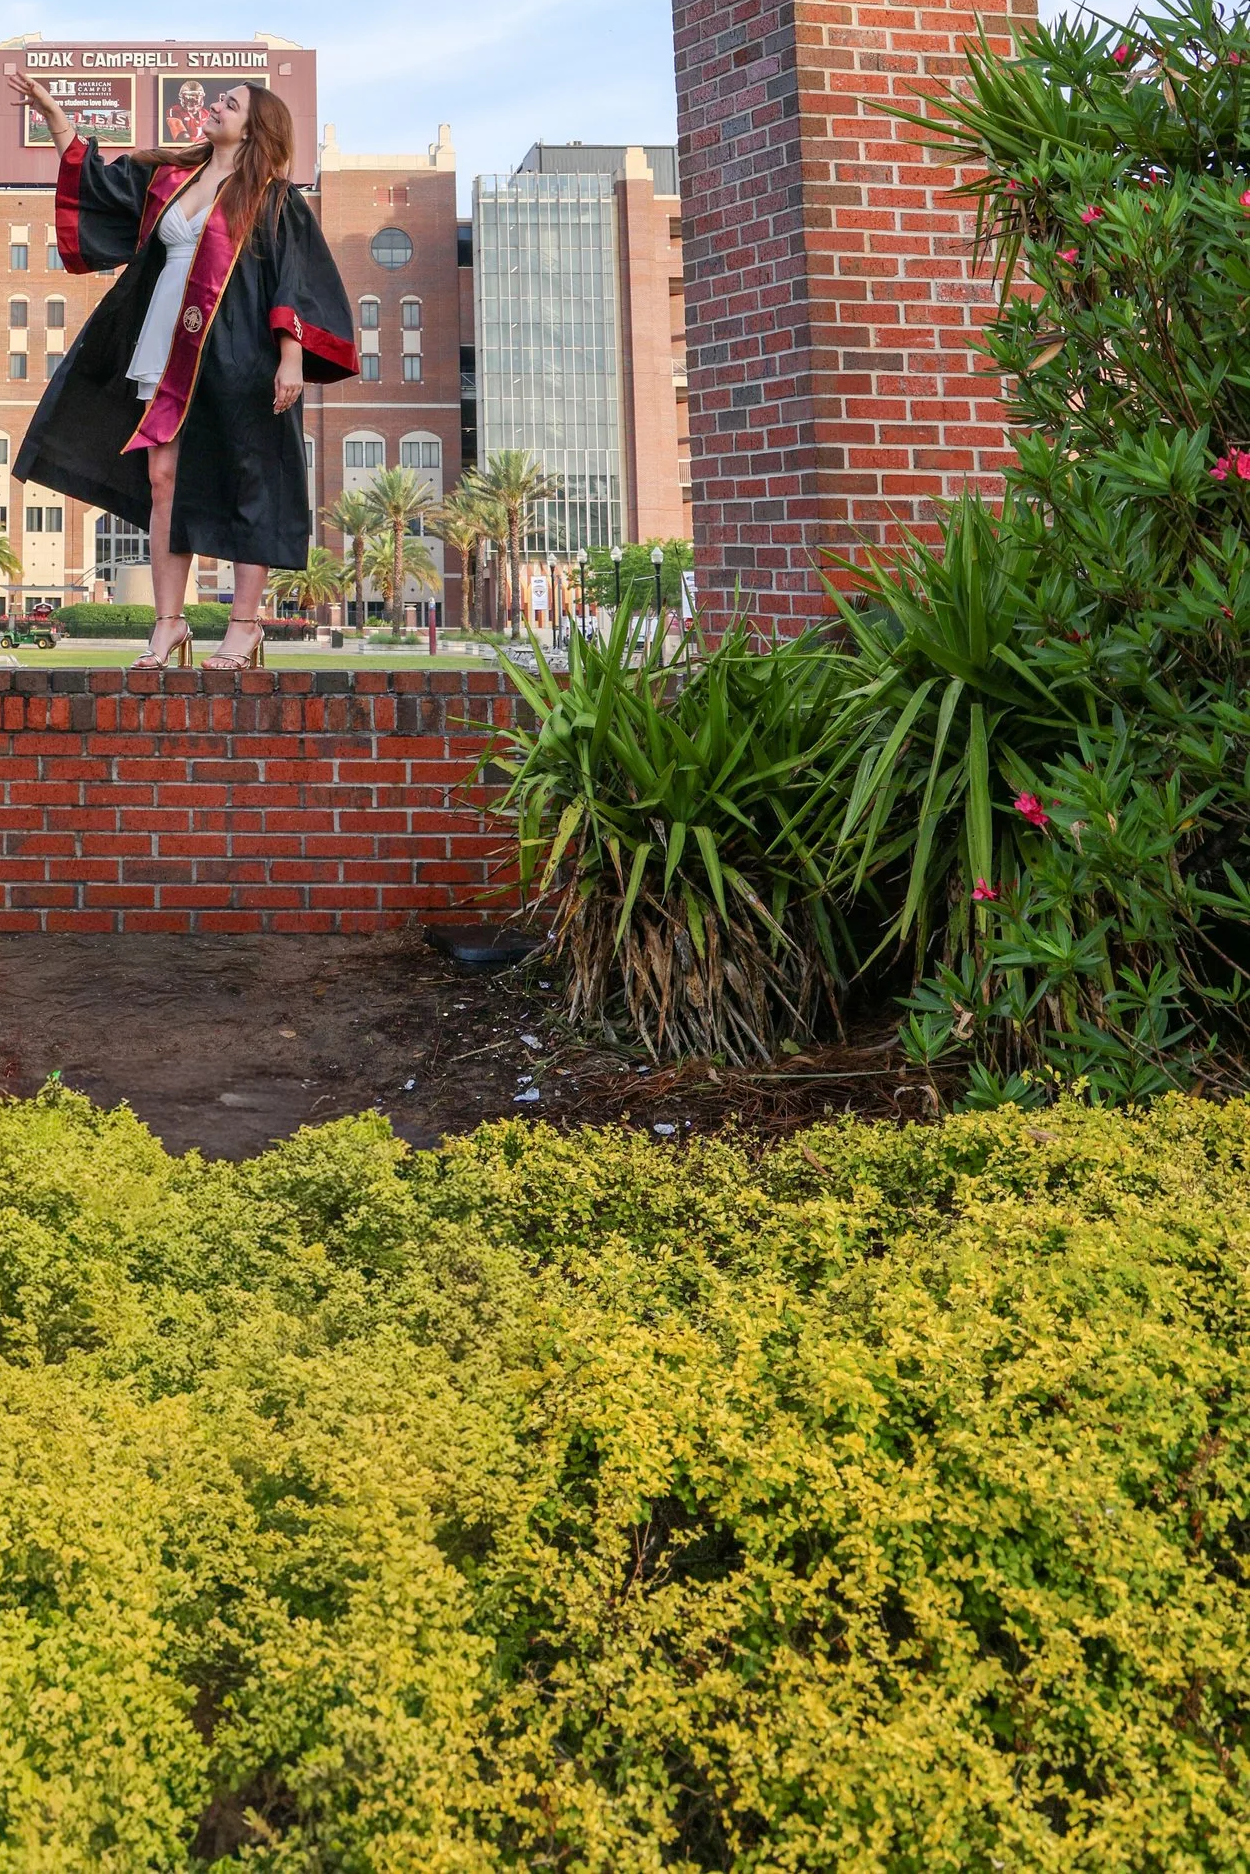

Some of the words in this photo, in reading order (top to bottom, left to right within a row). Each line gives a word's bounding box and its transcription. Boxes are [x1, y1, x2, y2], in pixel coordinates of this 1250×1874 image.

[26, 52, 74, 67] DOAK
[81, 52, 179, 67] CAMPBELL
[188, 52, 268, 67] STADIUM
[64, 99, 89, 107] students
[89, 99, 102, 107] love
